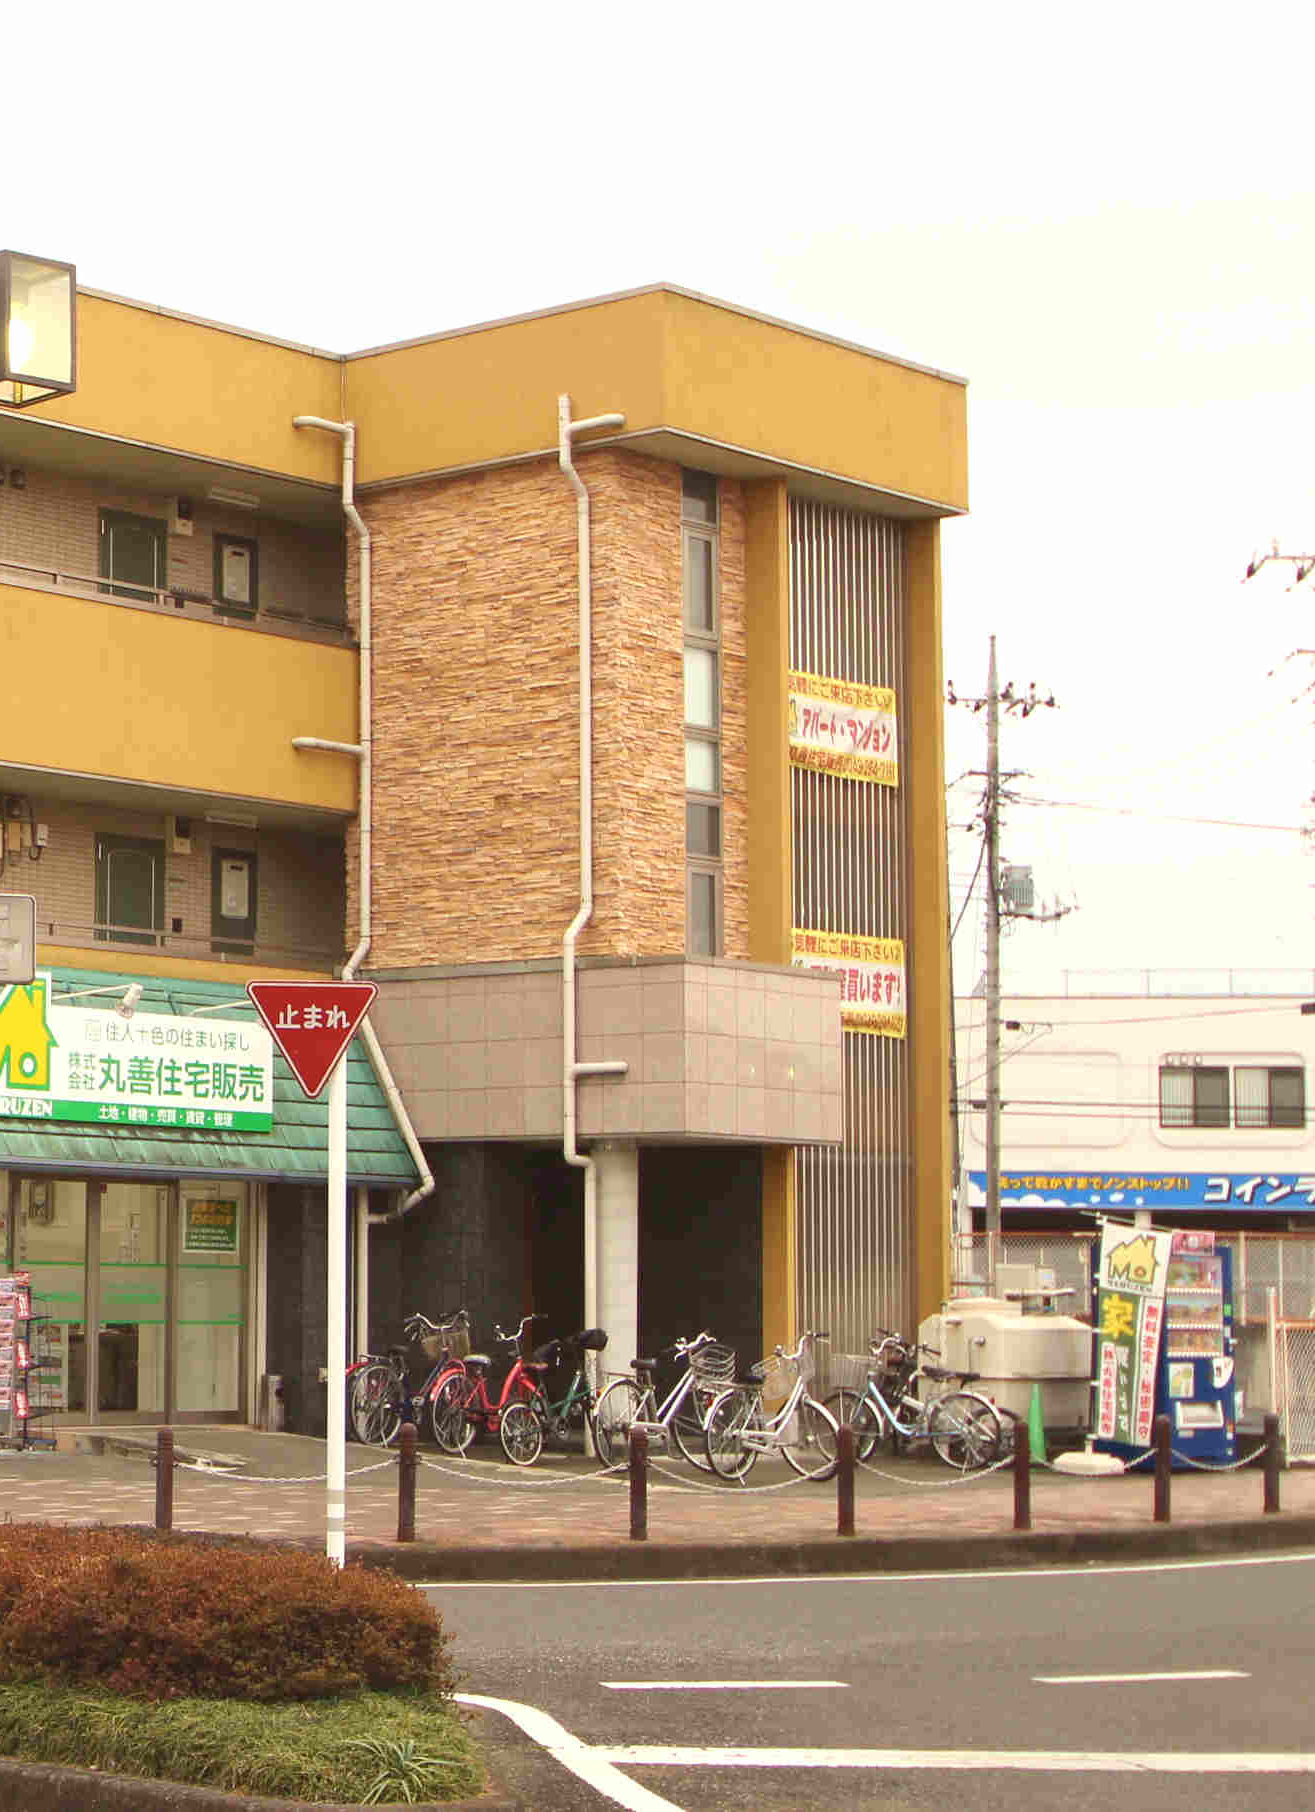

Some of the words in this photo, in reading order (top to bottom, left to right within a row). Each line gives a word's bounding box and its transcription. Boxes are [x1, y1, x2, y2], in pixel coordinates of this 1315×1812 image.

[275, 1004, 351, 1029] 止まれ
[99, 1054, 264, 1101] 丸善住宅販売
